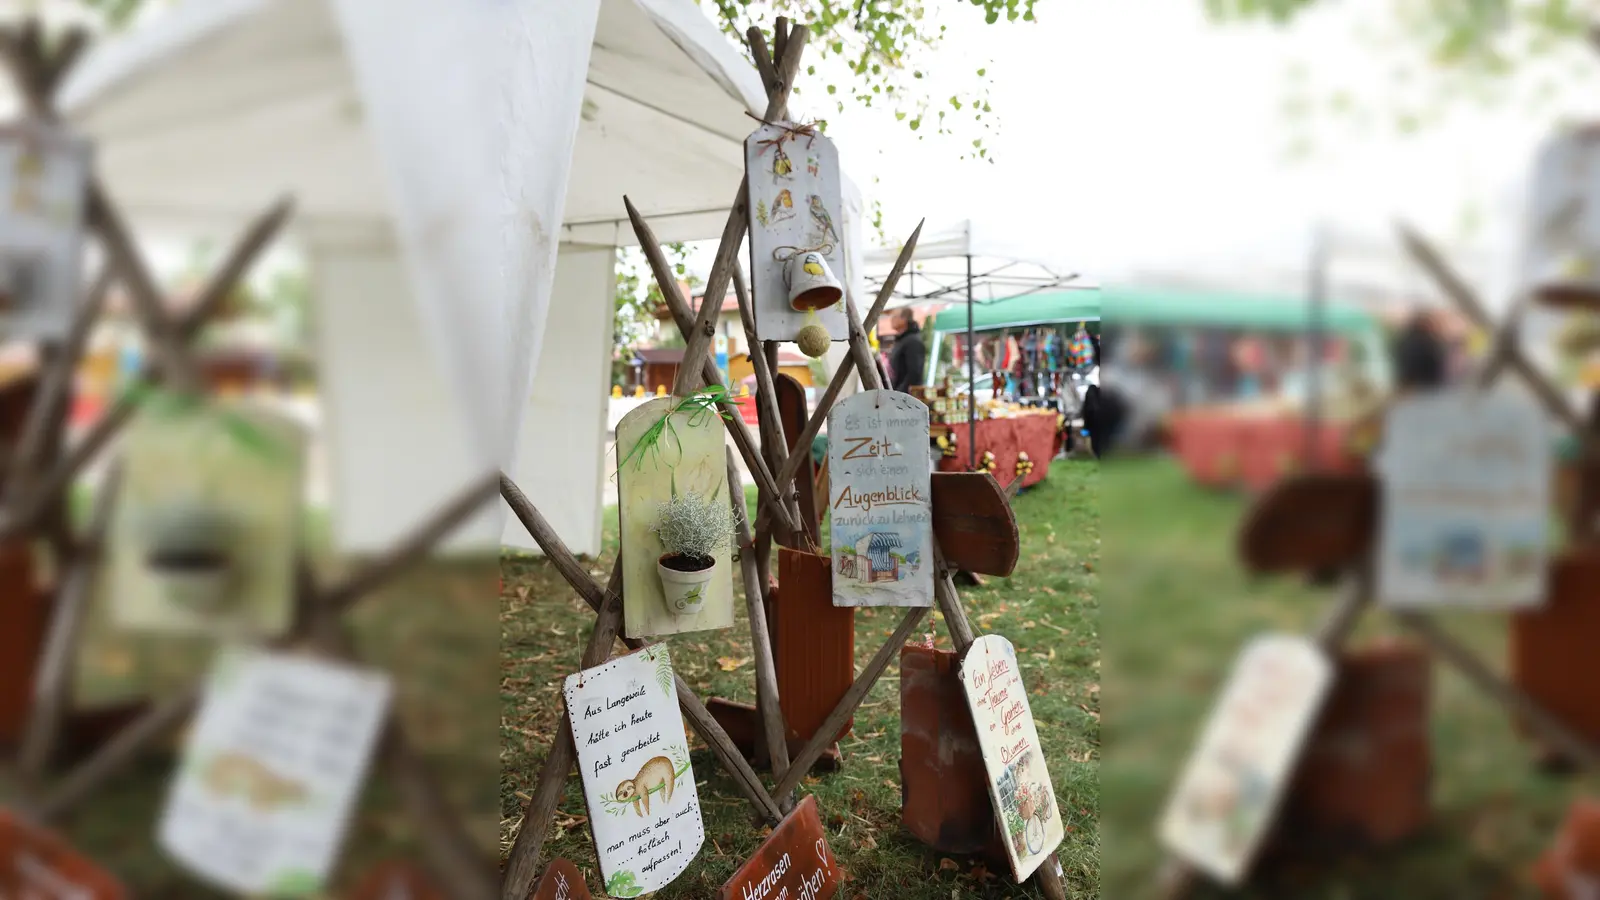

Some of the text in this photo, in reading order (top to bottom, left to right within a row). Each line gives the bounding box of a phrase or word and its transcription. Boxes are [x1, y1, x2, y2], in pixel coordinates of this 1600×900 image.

[868, 413, 882, 429] ist
[886, 416, 921, 428] immer
[842, 435, 902, 460] Zeit
[856, 461, 876, 476] sich
[834, 484, 919, 511] Augenblick
[973, 669, 986, 689] Ein
[584, 685, 646, 720] Aus Langeweile
[587, 709, 653, 745] hätte ich heute
[1001, 701, 1023, 735] Garten
[594, 732, 660, 778] fast gearbeitet
[606, 802, 694, 854] man muss aber auch
[637, 831, 670, 855] höllisch
[742, 852, 791, 900] Herzrasen
